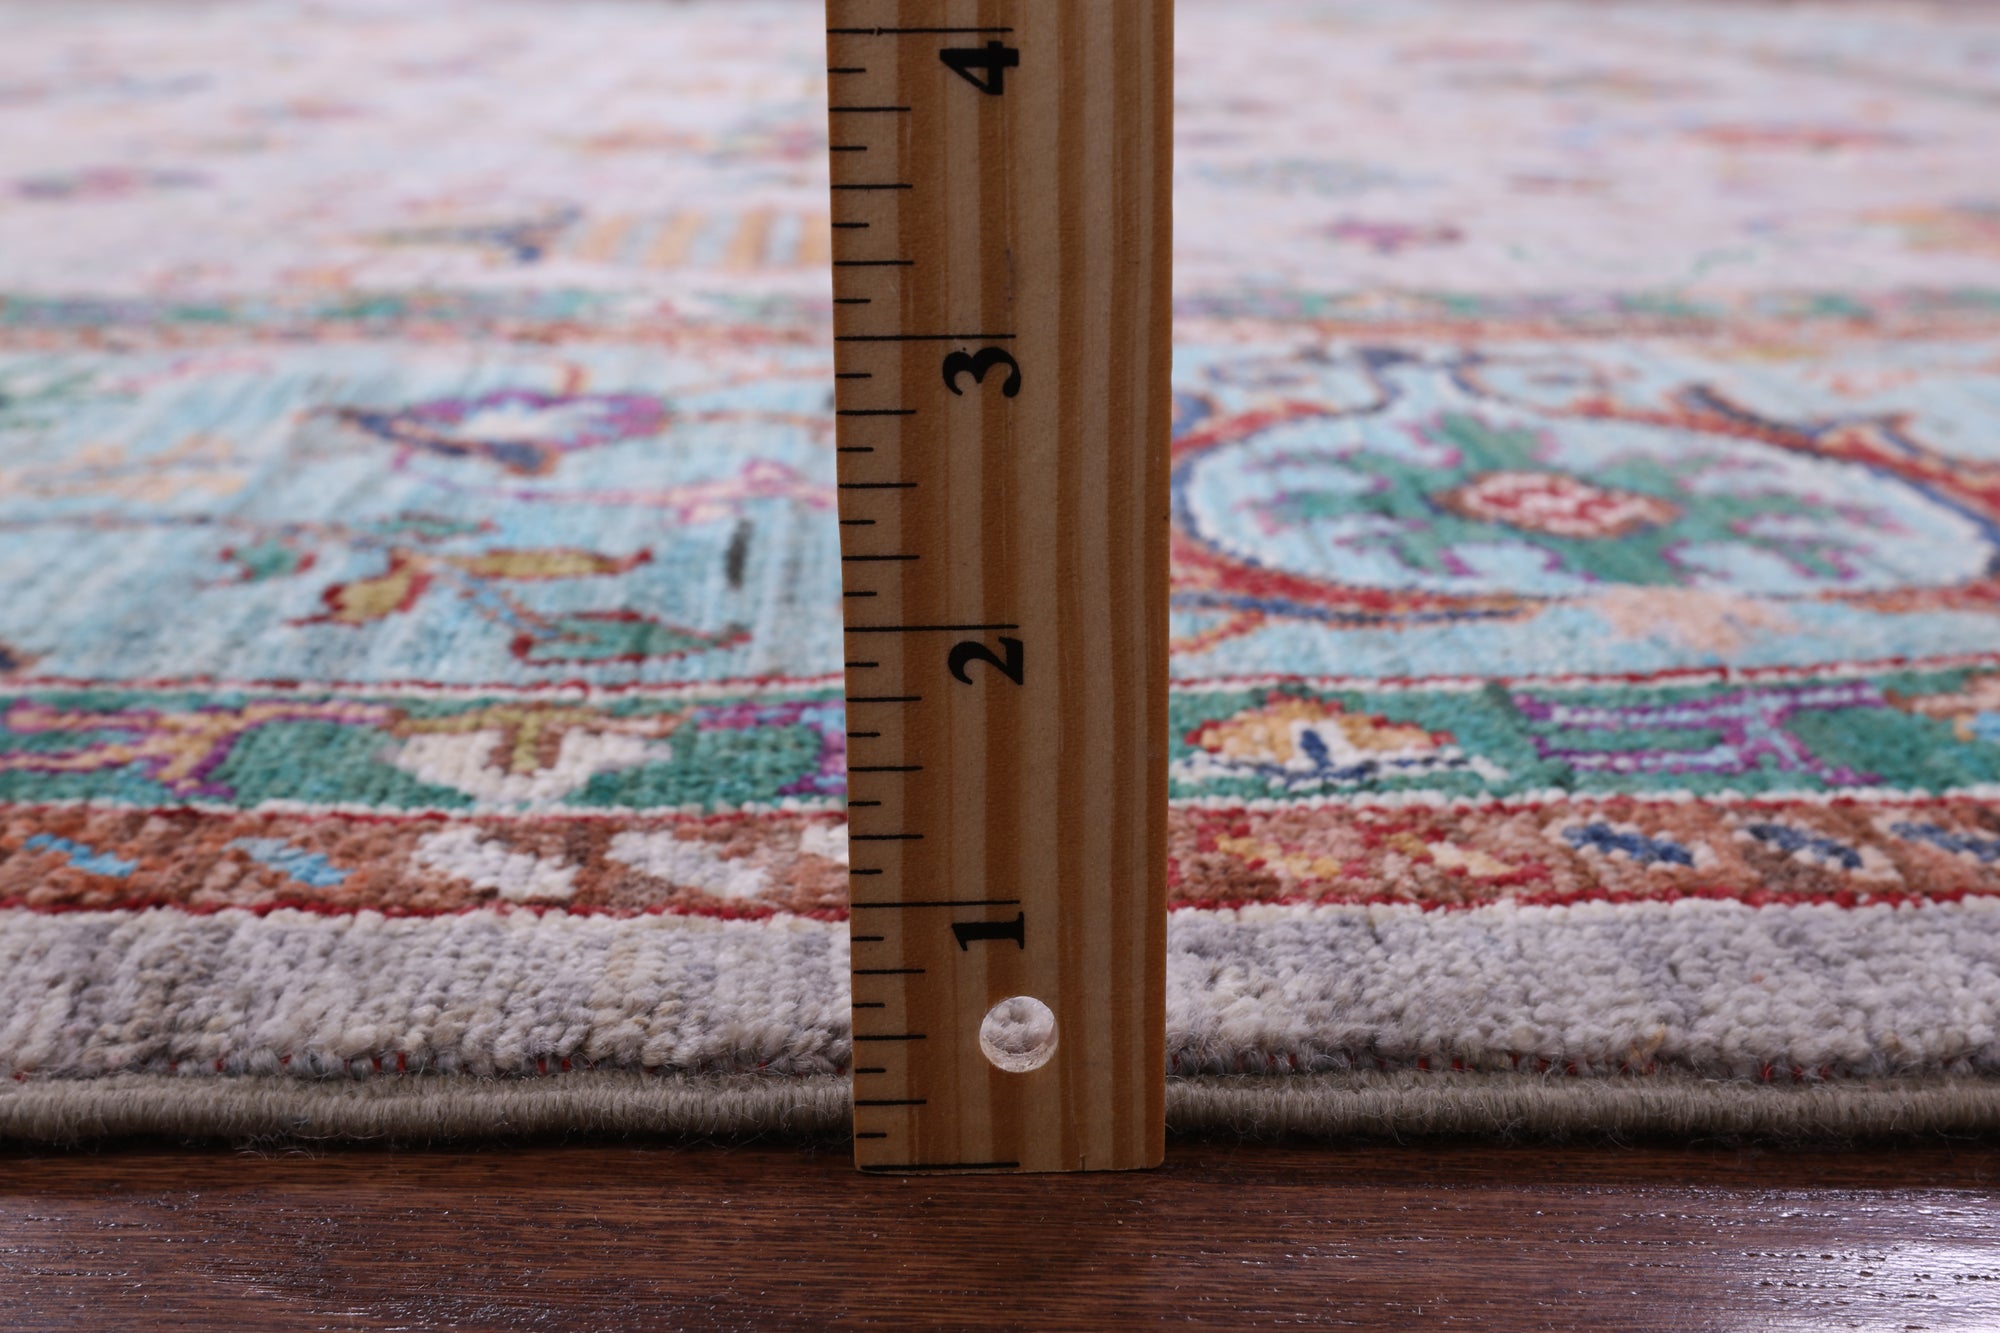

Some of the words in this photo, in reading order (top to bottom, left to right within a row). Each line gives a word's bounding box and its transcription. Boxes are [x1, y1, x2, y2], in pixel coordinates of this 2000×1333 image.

[939, 40, 1020, 96] 4
[942, 346, 1022, 398] 3
[947, 636, 1024, 686] 2
[951, 911, 1026, 952] 1
